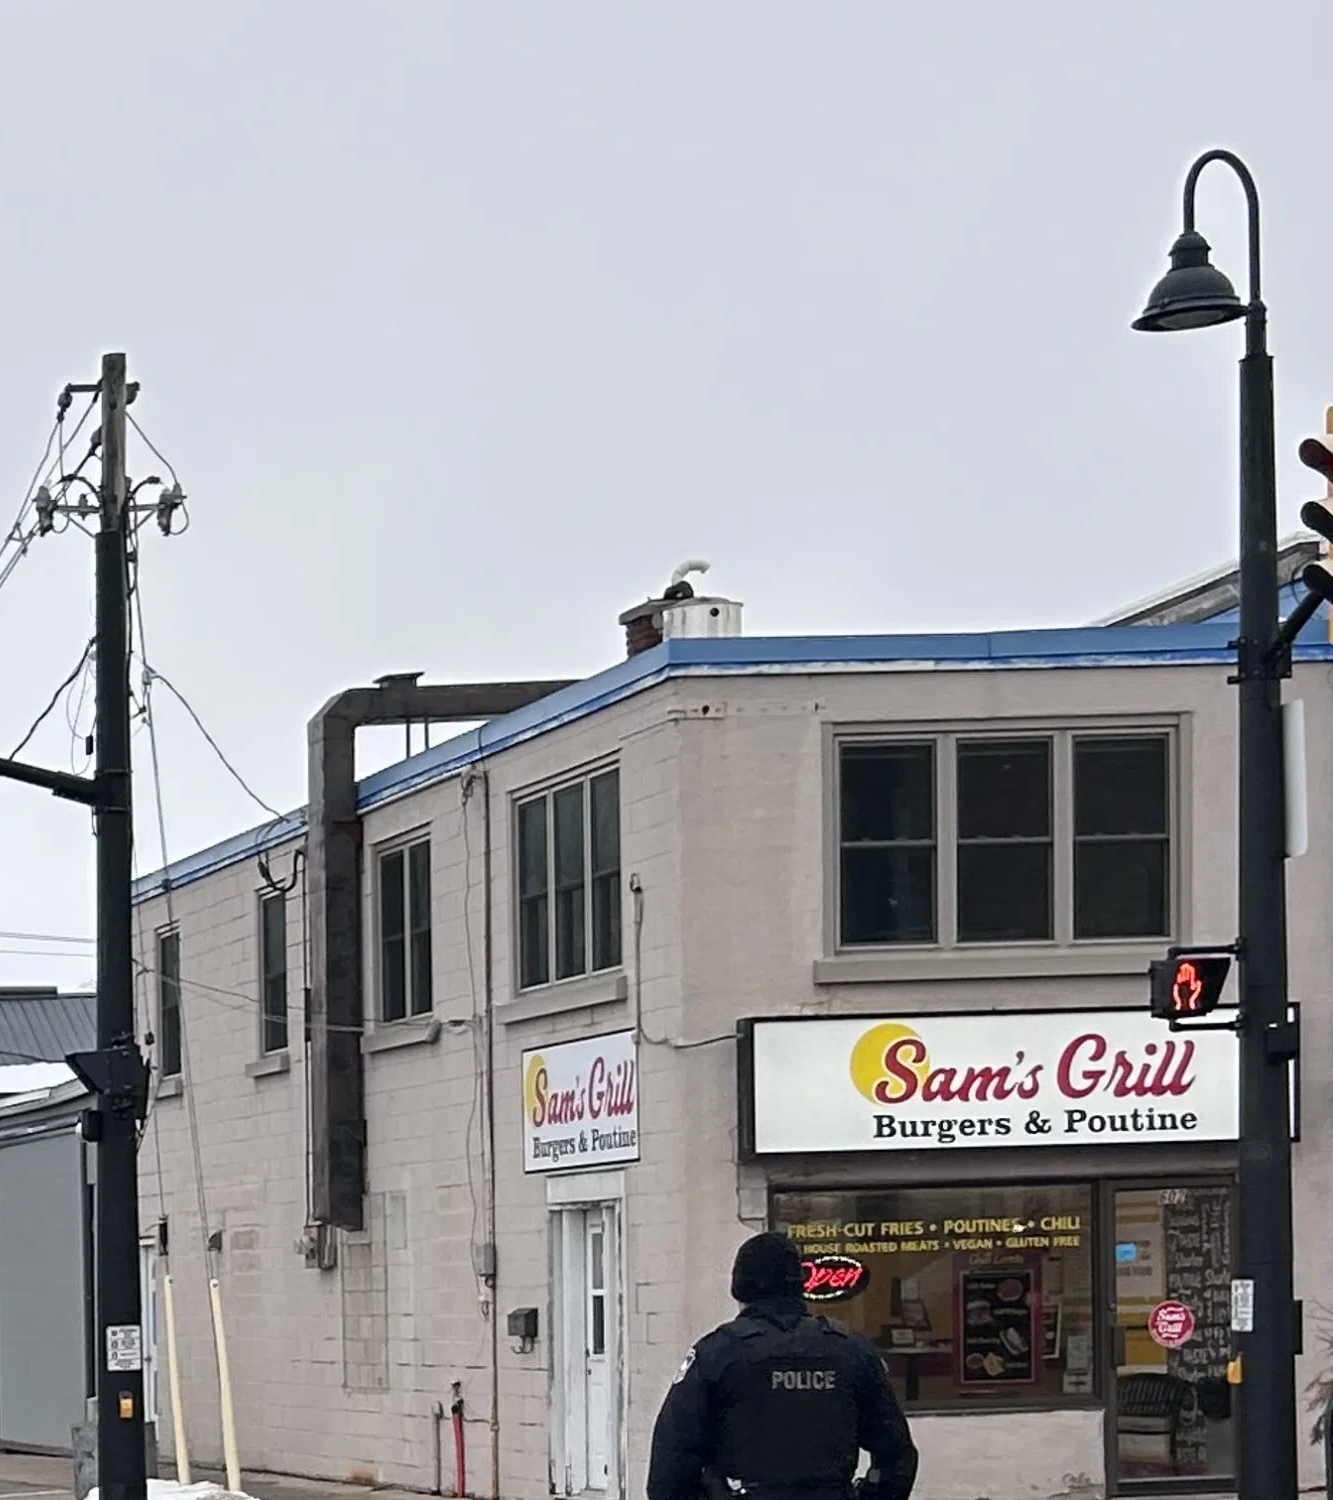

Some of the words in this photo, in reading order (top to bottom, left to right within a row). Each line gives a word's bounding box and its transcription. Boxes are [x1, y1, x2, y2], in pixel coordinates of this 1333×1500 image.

[874, 1038, 1044, 1104] Sam's
[1057, 1033, 1197, 1099] Grill
[533, 1067, 586, 1127] Sam's
[589, 1056, 634, 1119] Grill
[873, 1114, 1012, 1144] Burgers
[1024, 1110, 1052, 1134] &
[1064, 1107, 1198, 1133] Poutine
[533, 1136, 576, 1162] Burgers
[578, 1129, 588, 1153] &
[591, 1126, 637, 1152] Poutine
[787, 1222, 875, 1239] FRESH-CUT
[881, 1221, 924, 1235] FRIES
[944, 1217, 1022, 1234] POUTINES
[1040, 1216, 1080, 1231] CHILI
[803, 1242, 840, 1254] HOUSE
[844, 1241, 898, 1253] ROASTED
[900, 1239, 940, 1252] MEATS
[953, 1239, 993, 1250] VEGAN
[1005, 1236, 1049, 1249] GLUTEN
[1053, 1235, 1080, 1247] FREE
[772, 1370, 836, 1390] POLICE
